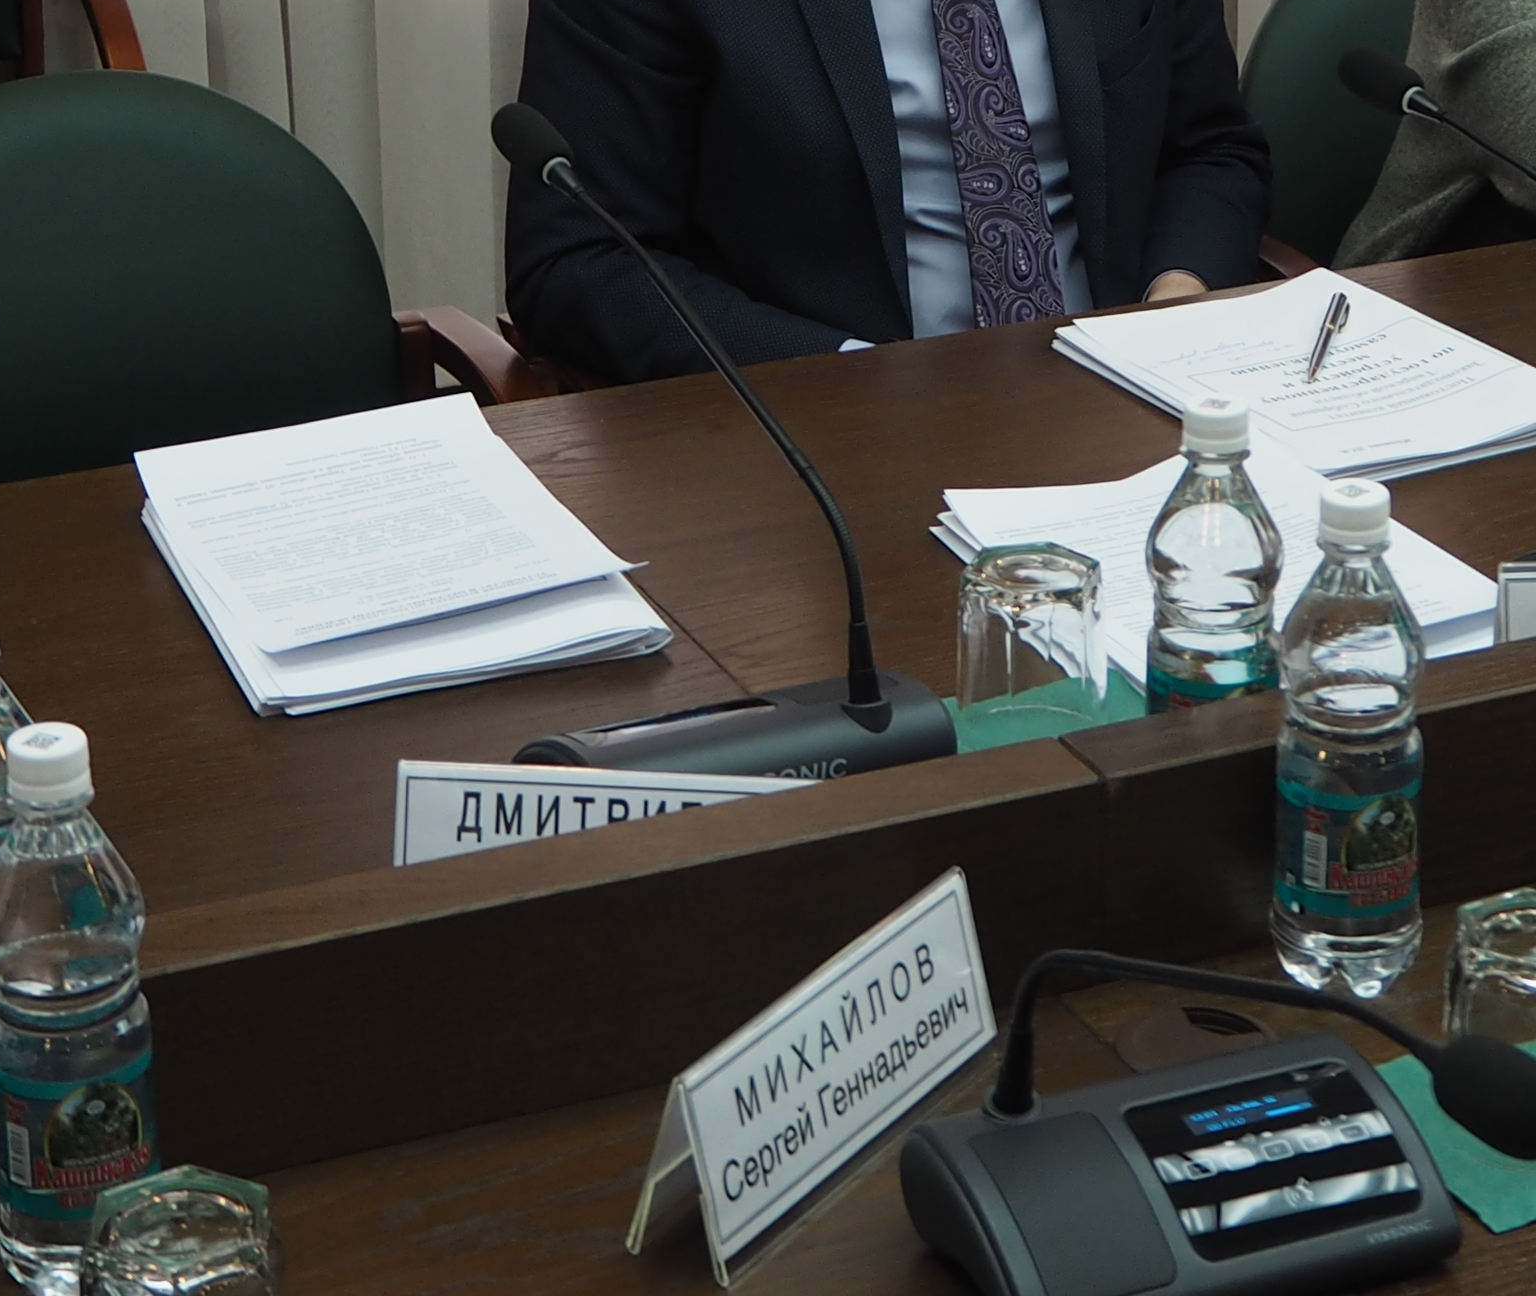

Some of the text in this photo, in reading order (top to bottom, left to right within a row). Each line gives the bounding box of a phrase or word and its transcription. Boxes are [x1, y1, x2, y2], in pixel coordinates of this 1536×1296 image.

[1260, 346, 1455, 405] по государственному
[1281, 381, 1296, 389] и
[722, 987, 970, 1202] Сергей Геннадьевич
[733, 942, 936, 1127] МИХАЙЛОВ
